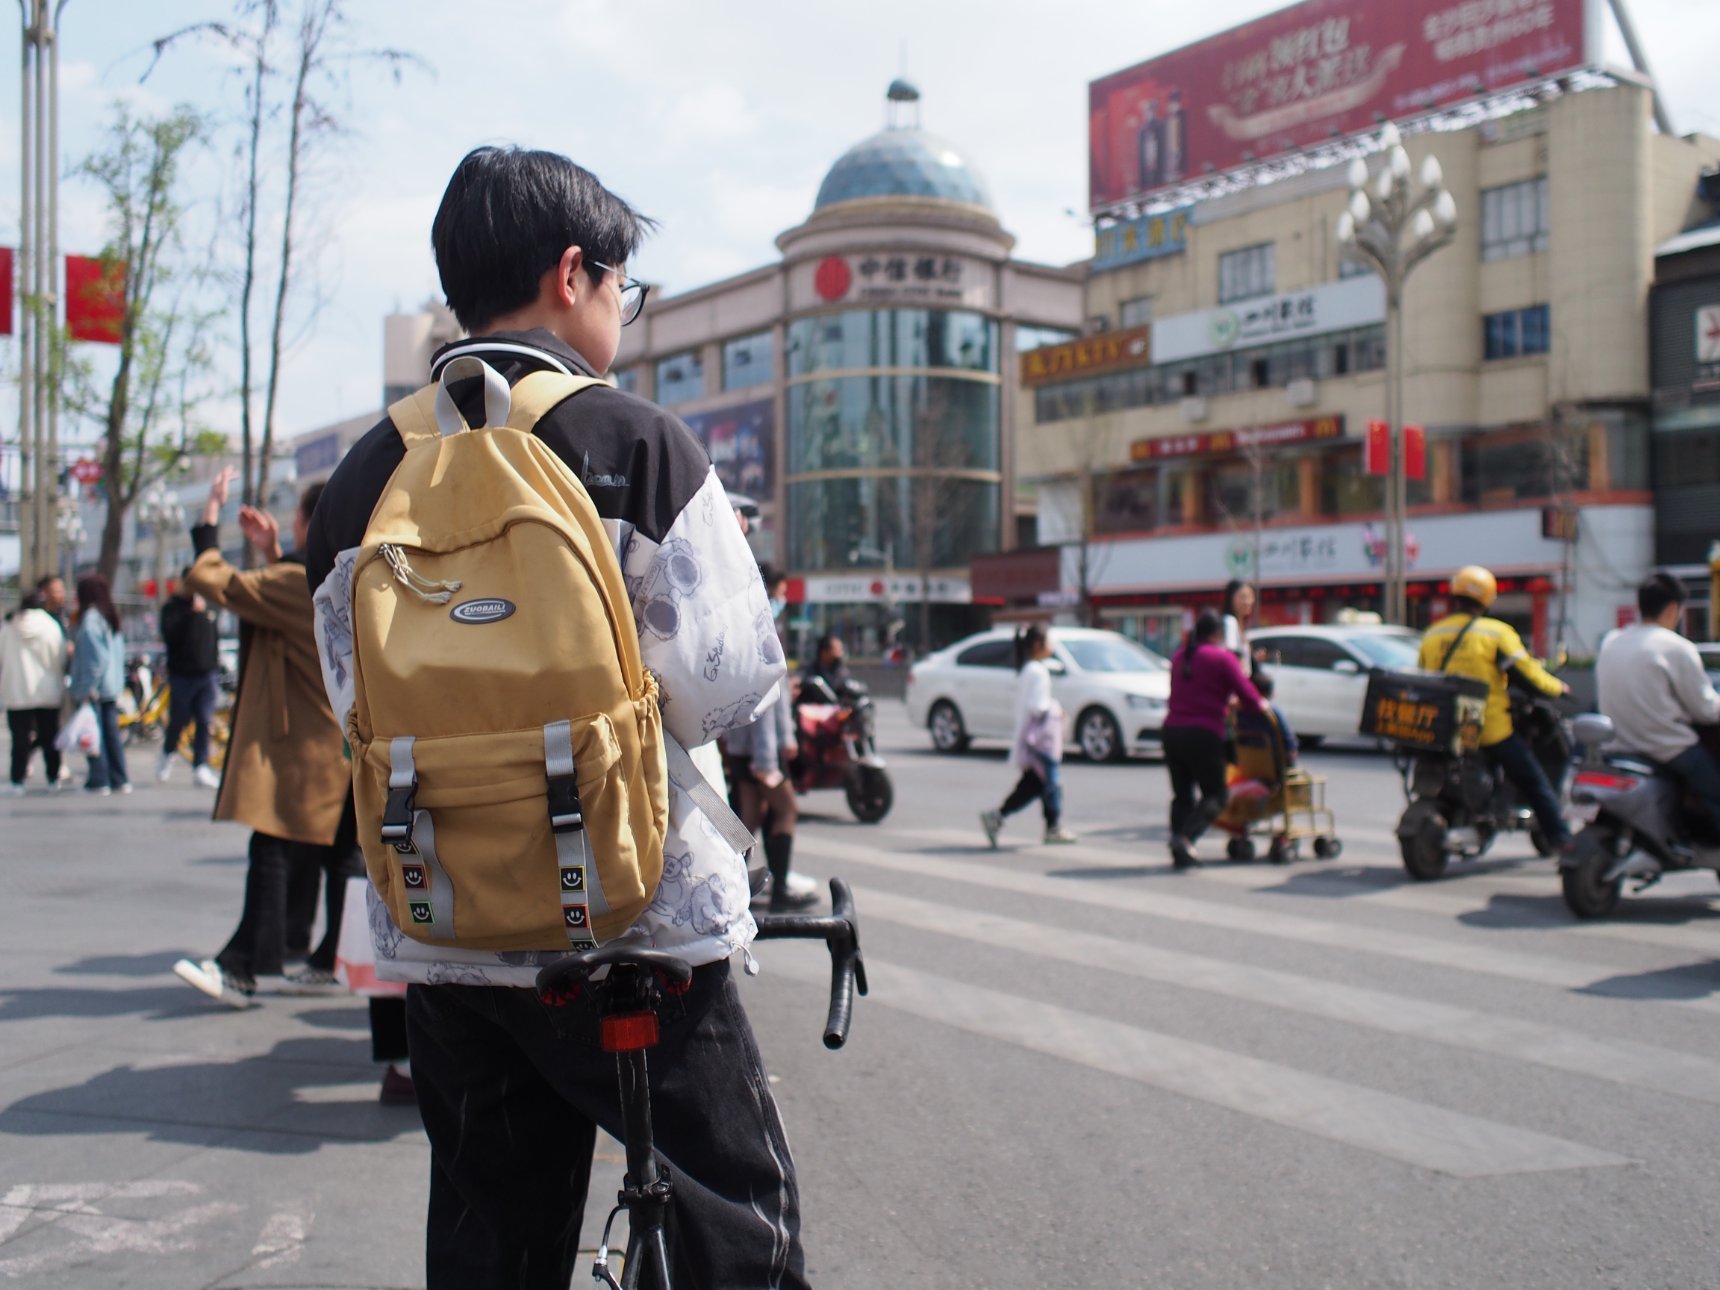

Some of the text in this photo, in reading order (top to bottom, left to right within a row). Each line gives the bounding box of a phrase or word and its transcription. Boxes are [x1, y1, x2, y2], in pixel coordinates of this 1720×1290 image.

[859, 255, 962, 285] 中信银行
[464, 604, 506, 613] ZUOBAILI
